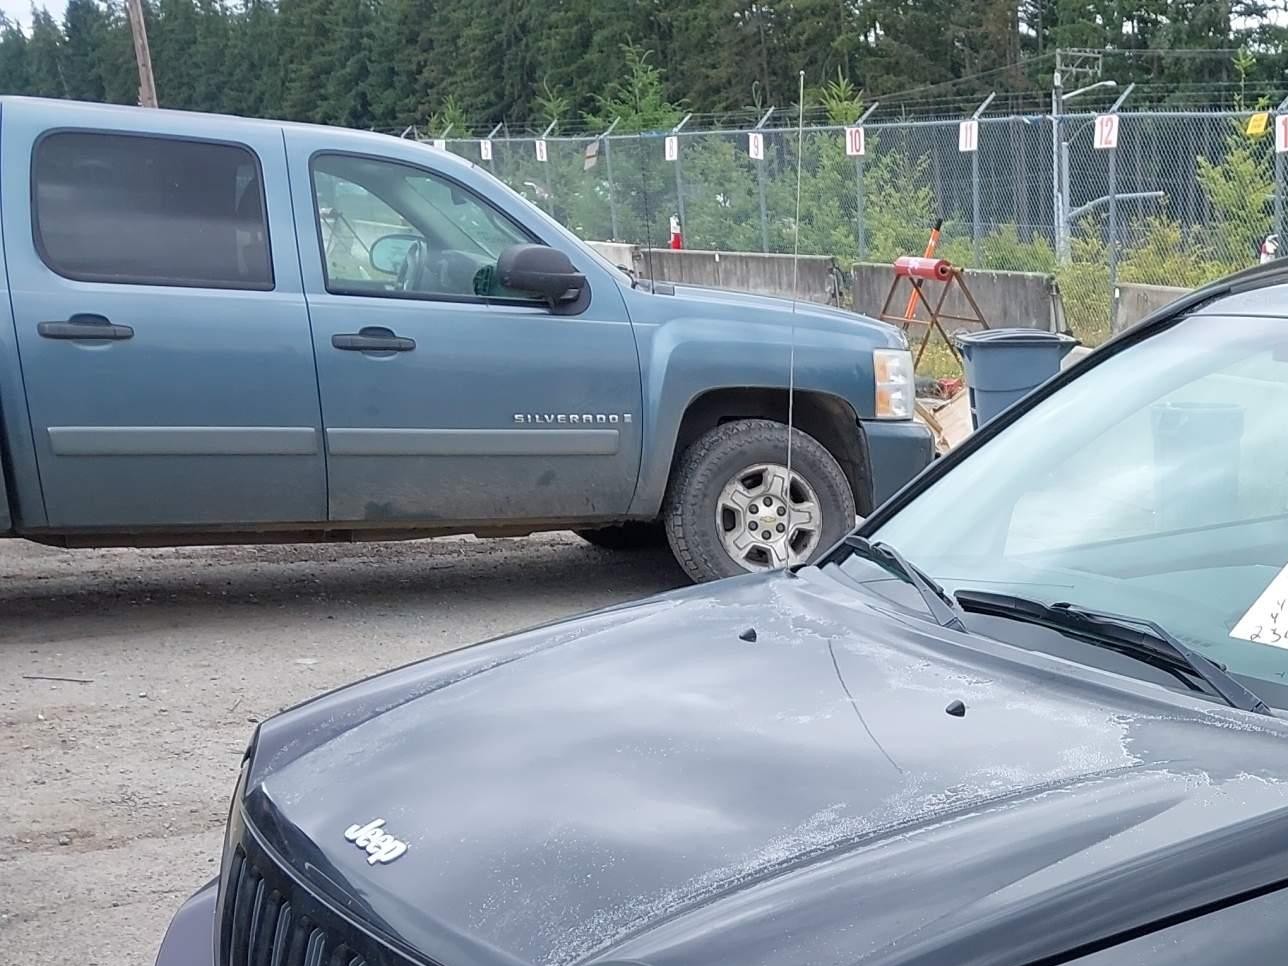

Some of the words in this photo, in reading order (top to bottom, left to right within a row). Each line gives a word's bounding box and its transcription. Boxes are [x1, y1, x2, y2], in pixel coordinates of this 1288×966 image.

[849, 129, 861, 153] 10
[964, 123, 973, 148] 11
[1099, 117, 1114, 146] 12
[753, 134, 760, 157] 9
[514, 413, 619, 424] SILVERADO
[344, 818, 408, 865] Jeep
